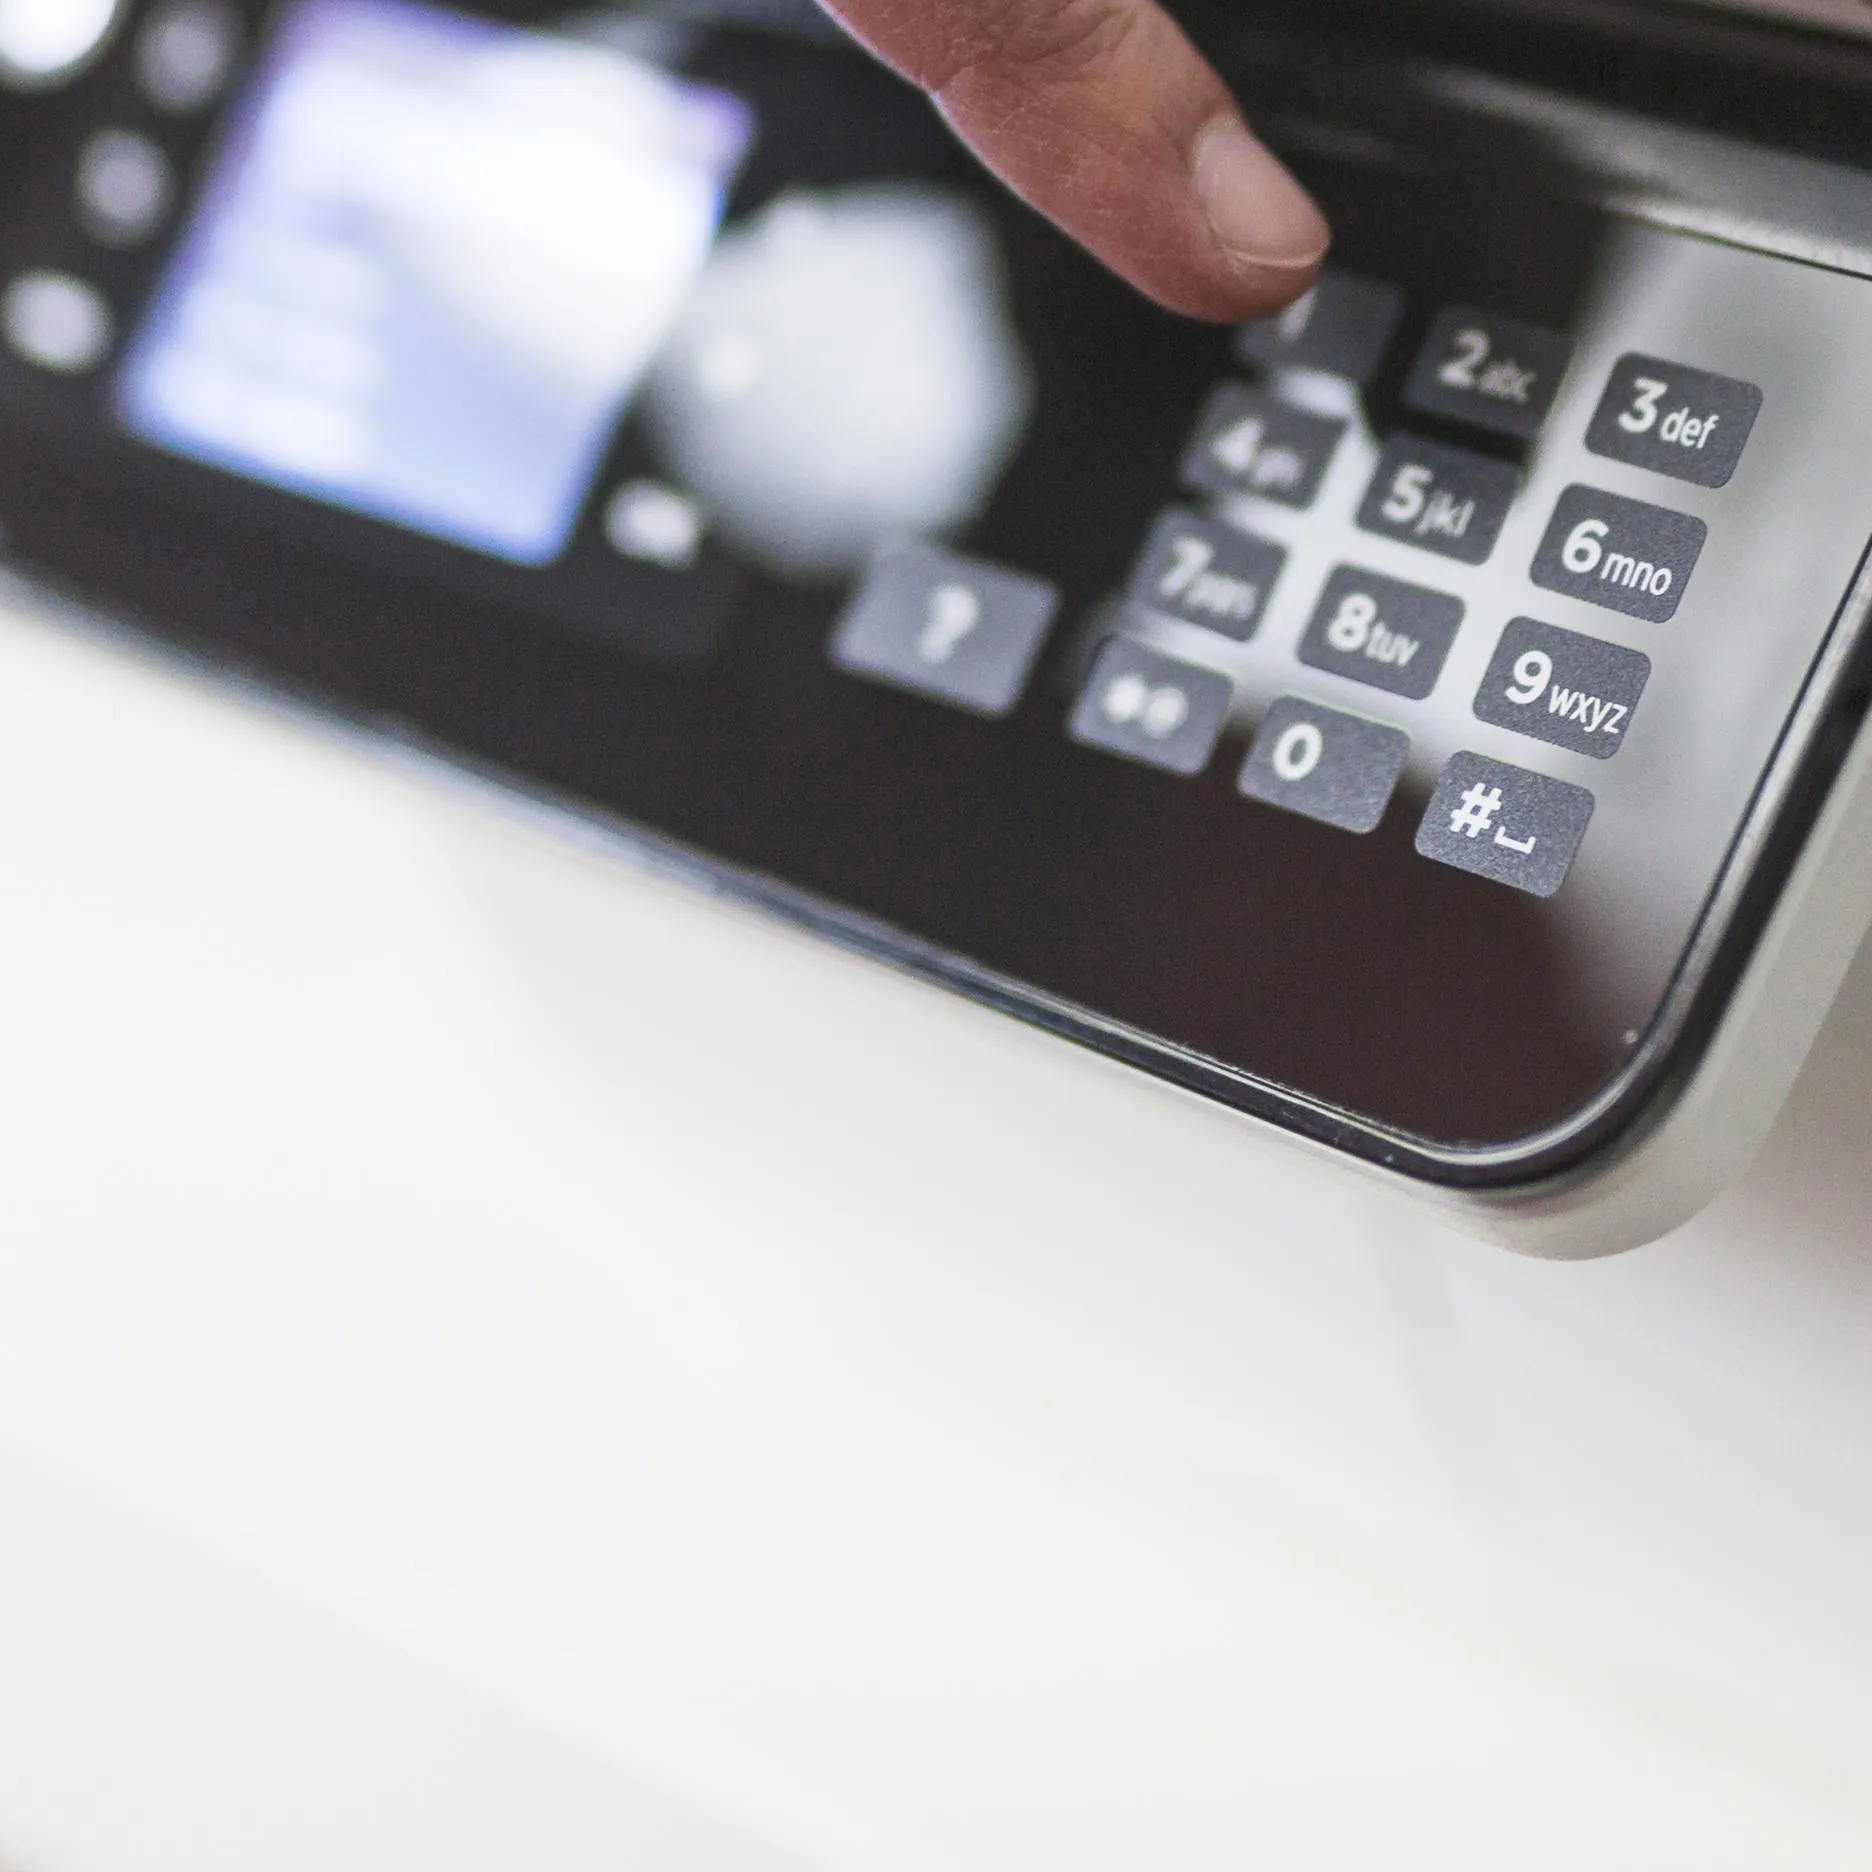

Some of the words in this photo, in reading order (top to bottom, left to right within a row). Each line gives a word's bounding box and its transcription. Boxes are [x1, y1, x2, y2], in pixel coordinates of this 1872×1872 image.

[1437, 328, 1492, 389] 2
[1618, 377, 1669, 434] 3
[1659, 406, 1720, 450] def
[1380, 463, 1434, 523] 5
[1159, 536, 1216, 597] 7
[1561, 519, 1610, 574] 6
[1600, 551, 1673, 596] mno
[1328, 592, 1378, 653] 8
[1364, 621, 1421, 668] tuv
[1505, 650, 1554, 705] 9
[1548, 684, 1629, 735] wxyz
